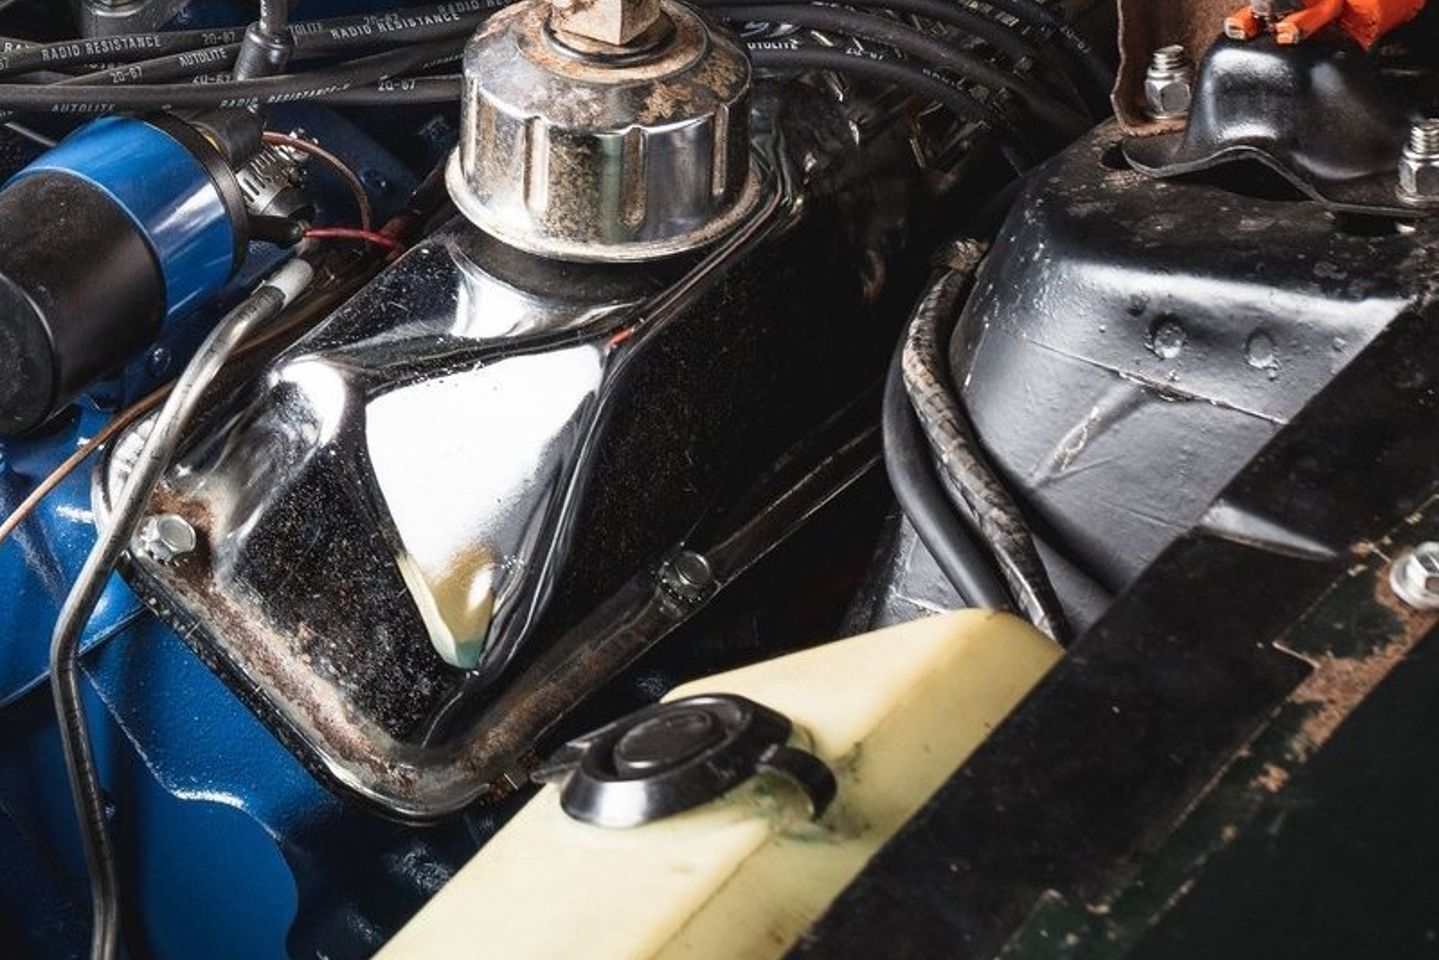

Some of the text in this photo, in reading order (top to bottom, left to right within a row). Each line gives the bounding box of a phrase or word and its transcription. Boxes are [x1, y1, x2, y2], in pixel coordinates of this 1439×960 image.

[331, 23, 372, 40] RADIO
[41, 43, 81, 61] RADIO
[86, 35, 161, 56] RESISTANCE
[179, 47, 228, 67] AUTOLITE
